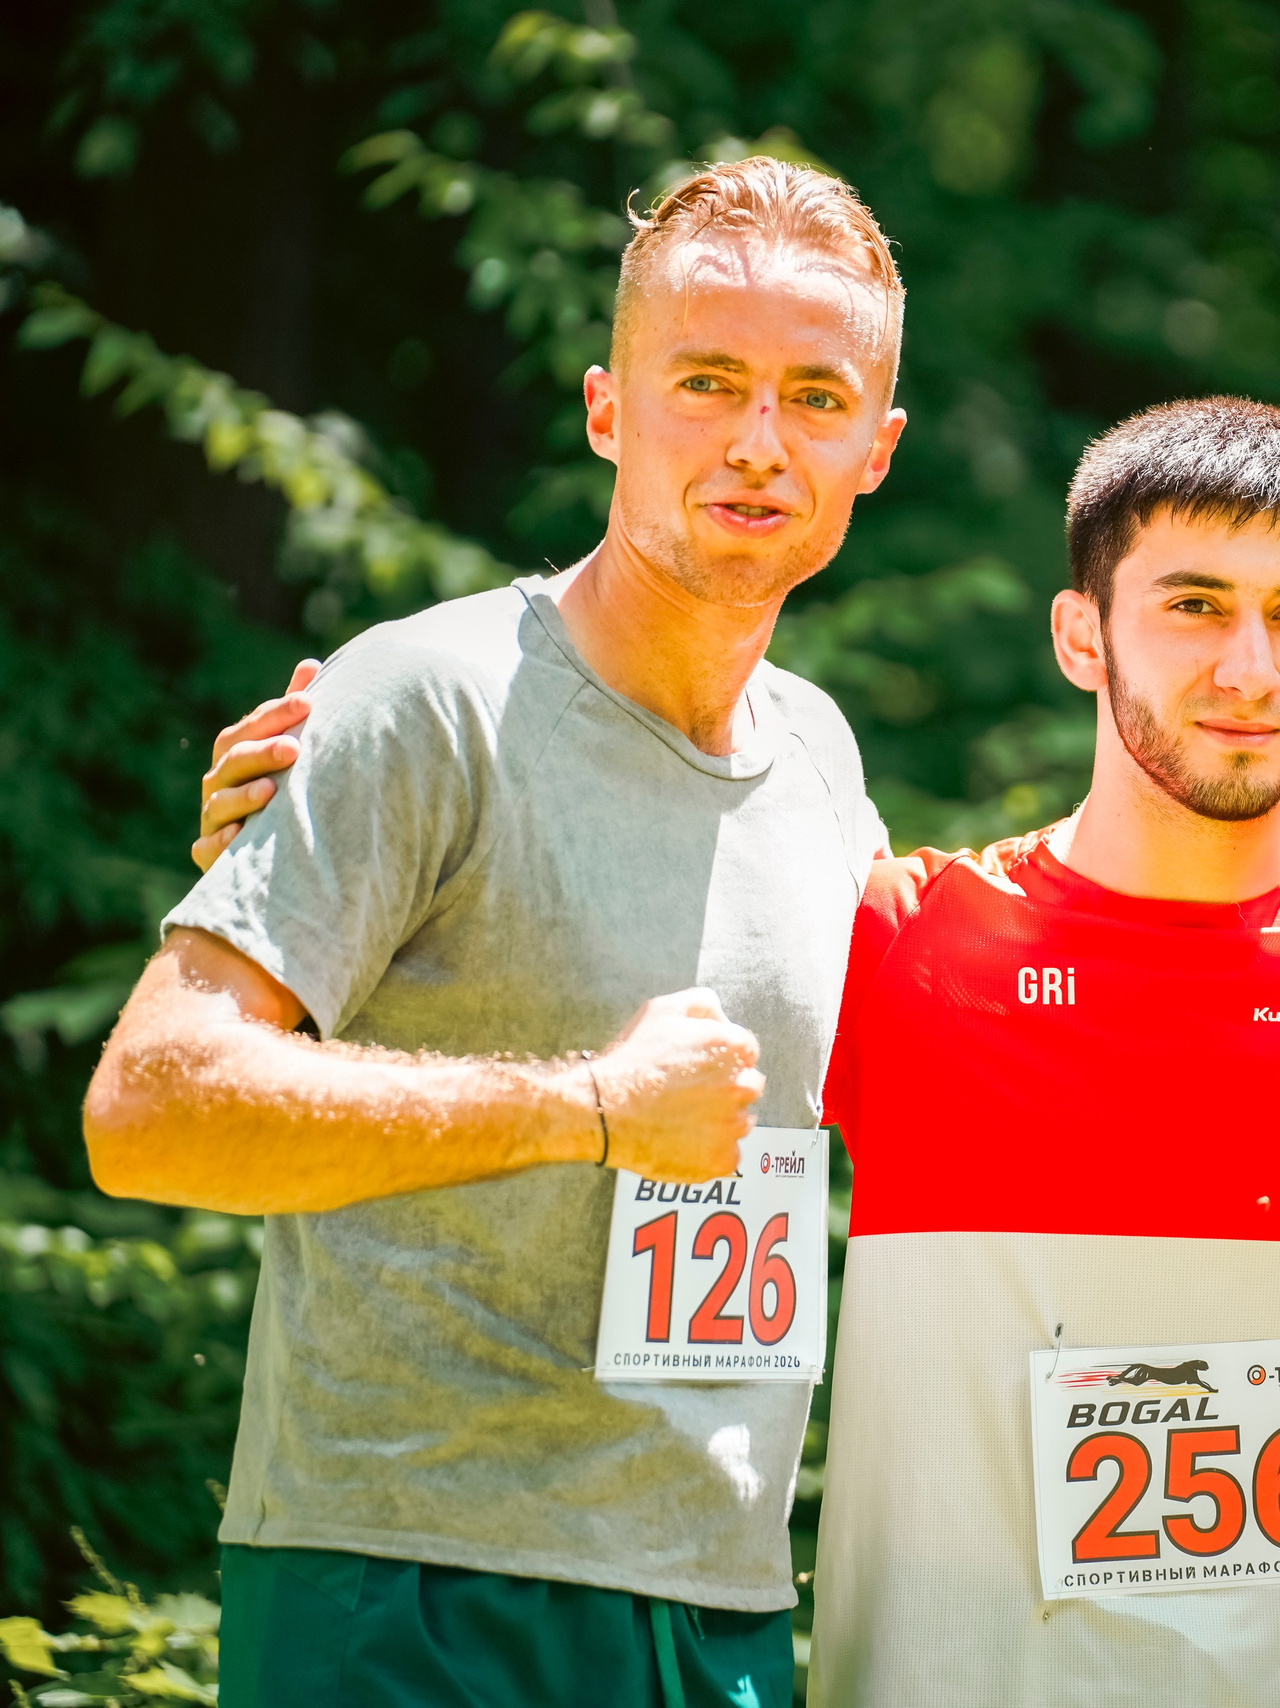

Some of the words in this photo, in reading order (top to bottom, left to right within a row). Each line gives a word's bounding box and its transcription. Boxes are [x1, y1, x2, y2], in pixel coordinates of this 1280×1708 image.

[635, 1177, 741, 1205] BOGAL
[632, 1209, 797, 1346] 126
[614, 1353, 711, 1368] СПОРТИВНЫЙ
[715, 1355, 771, 1368] МАРАФОН
[774, 1355, 800, 1368] 2026
[1066, 1397, 1219, 1428] BOGAL
[1064, 1566, 1197, 1587] СПОРТИВНЫЙ
